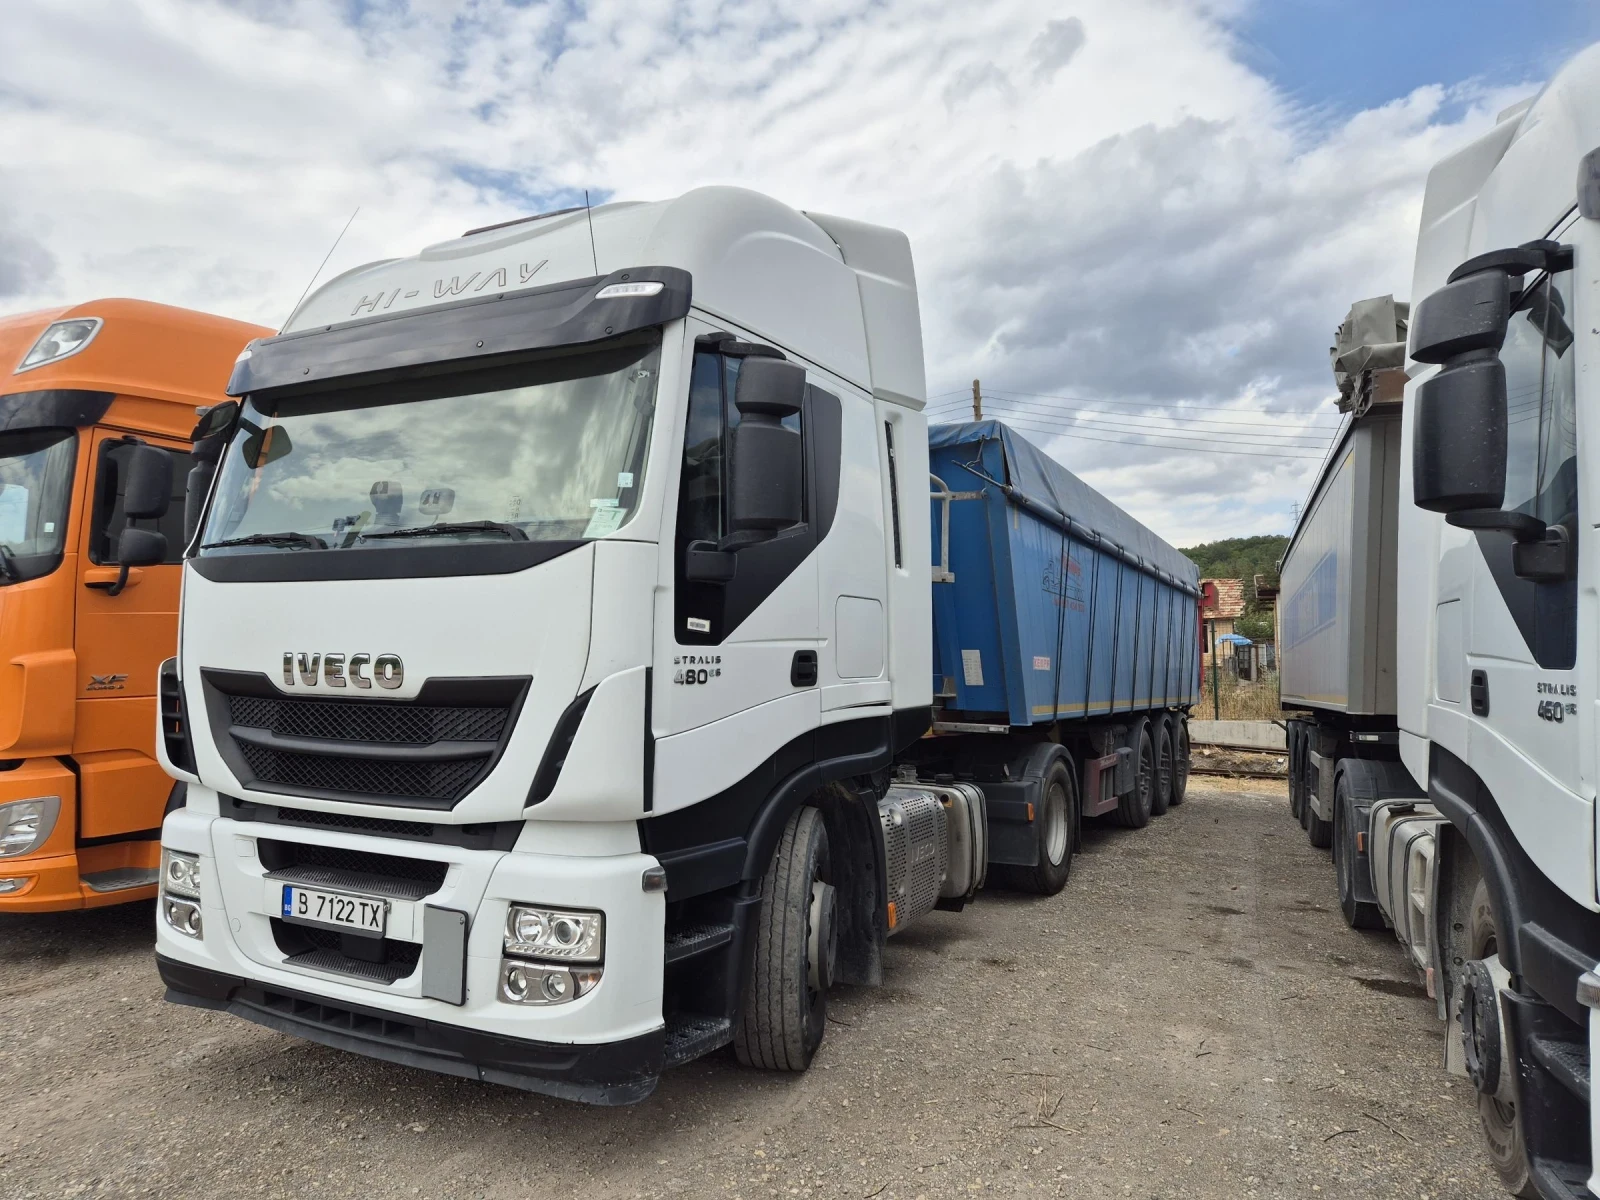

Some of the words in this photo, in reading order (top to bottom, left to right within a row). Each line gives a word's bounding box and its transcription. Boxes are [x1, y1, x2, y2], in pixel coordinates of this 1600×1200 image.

[674, 655, 721, 665] STRALIS
[89, 673, 128, 685] XF
[283, 652, 404, 689] IVECO
[1537, 682, 1577, 696] STRALIS
[911, 842, 935, 864] IVECO
[299, 892, 308, 915] B
[317, 895, 355, 923] 7122
[359, 901, 380, 928] TX
